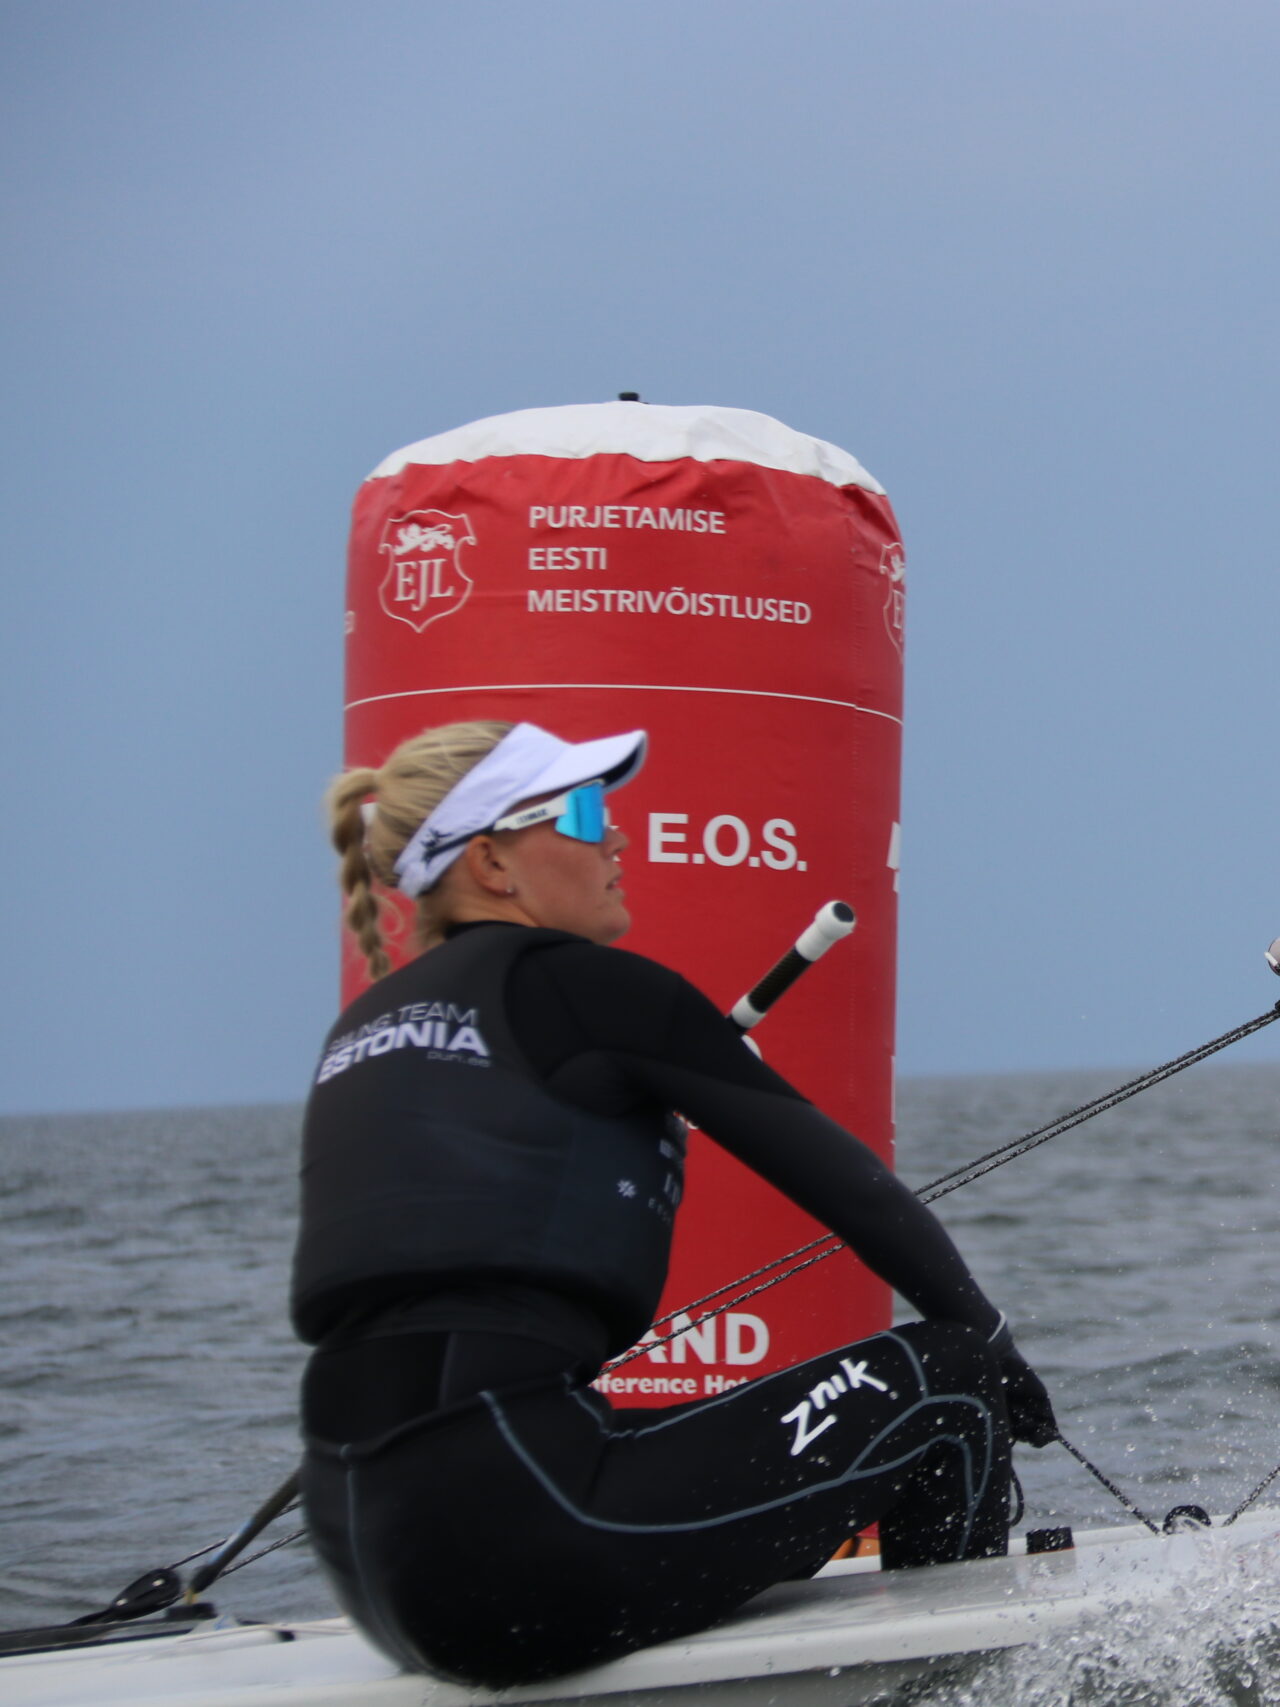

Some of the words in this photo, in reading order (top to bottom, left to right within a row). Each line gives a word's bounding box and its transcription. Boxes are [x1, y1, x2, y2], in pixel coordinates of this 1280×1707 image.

[528, 505, 727, 535] PURJETAMISE
[527, 547, 607, 571] EESTI
[393, 557, 455, 612] EJL
[526, 587, 812, 625] MEISTRIVÕISTLUSED
[647, 812, 808, 872] E.O.S.
[397, 1001, 479, 1027] TEAM
[315, 1020, 490, 1085] ESTONIA
[605, 1311, 770, 1366] AND
